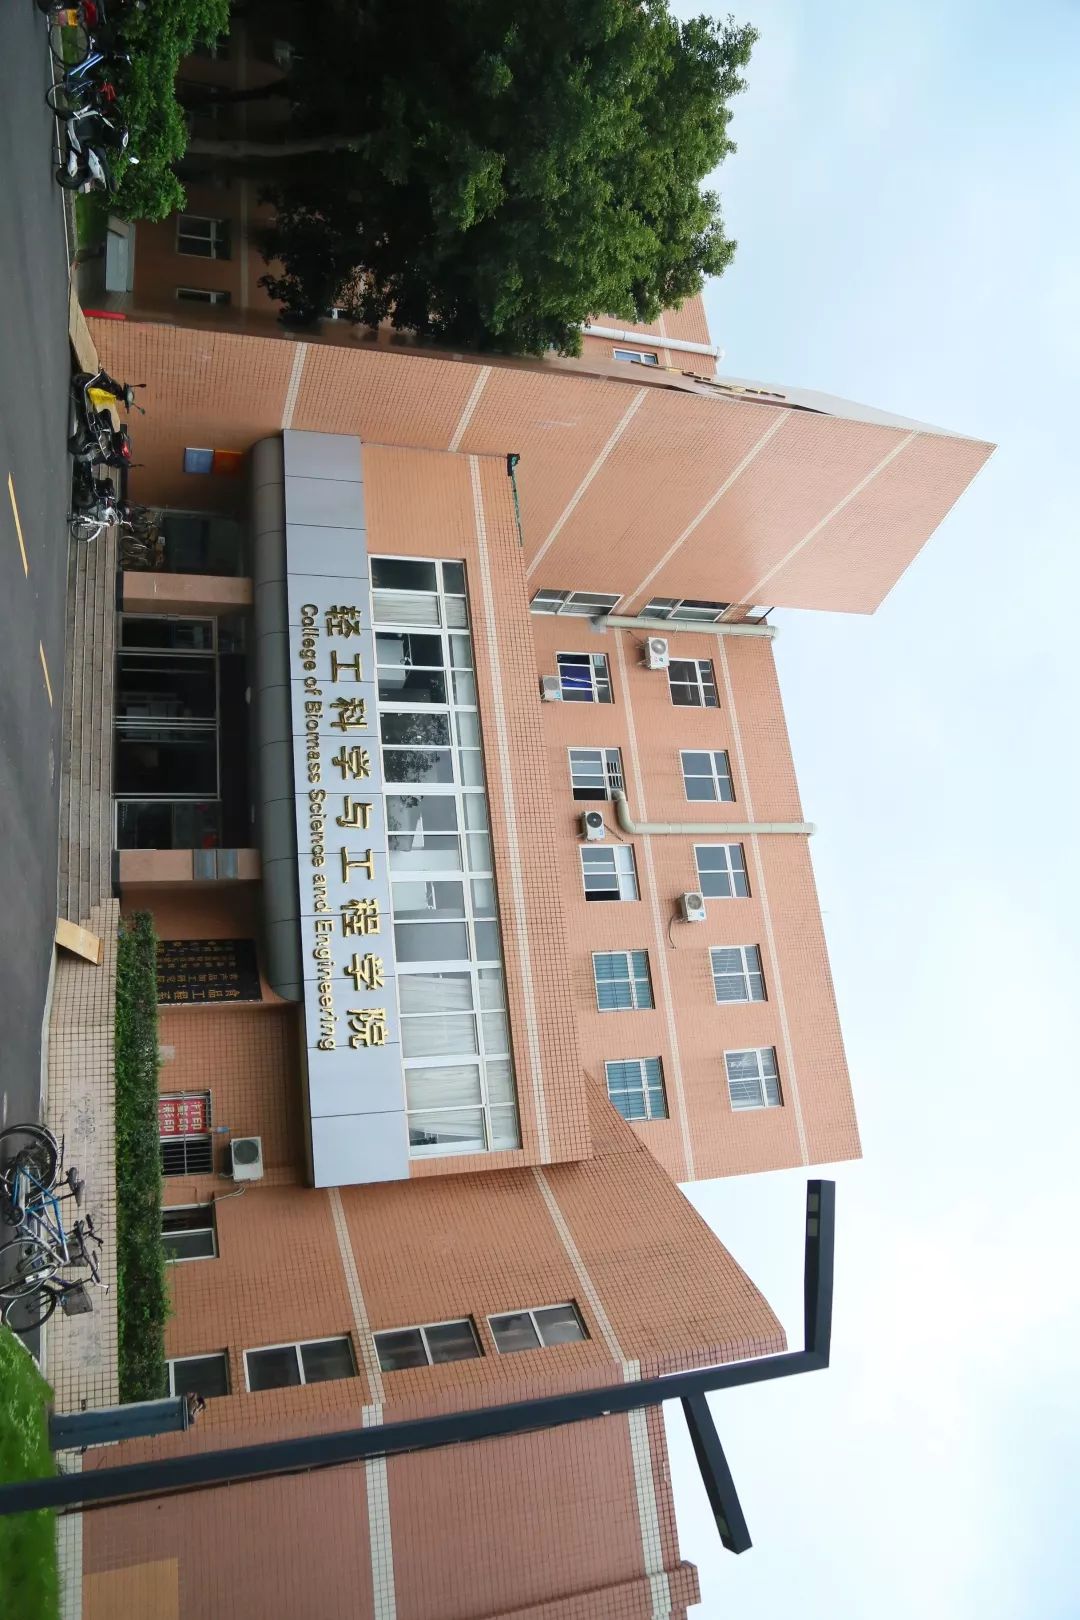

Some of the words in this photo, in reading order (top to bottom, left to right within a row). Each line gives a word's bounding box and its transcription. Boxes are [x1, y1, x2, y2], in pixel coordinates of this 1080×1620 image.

[299, 604, 320, 671] College
[304, 676, 322, 696] of
[305, 700, 324, 783] Biomass
[308, 789, 328, 867] Science
[325, 605, 389, 1049] 轻工科学与工程学院
[313, 873, 333, 913] and
[157, 989, 240, 1001] 食品工程系
[313, 920, 340, 1051] Engineering
[190, 1102, 202, 1130] 打印
